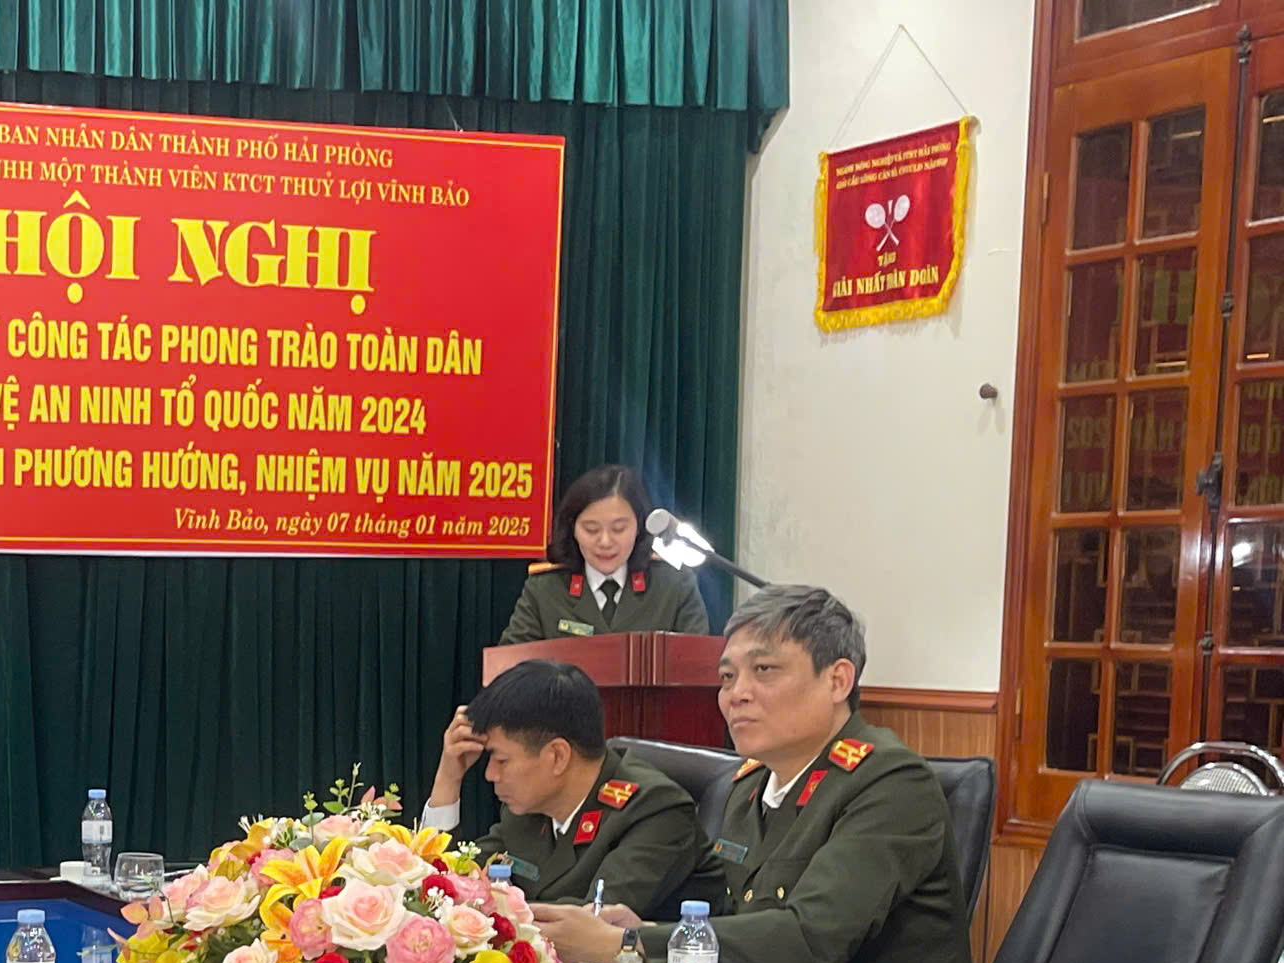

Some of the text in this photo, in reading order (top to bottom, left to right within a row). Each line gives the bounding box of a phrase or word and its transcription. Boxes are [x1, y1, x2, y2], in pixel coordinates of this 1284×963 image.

[39, 156, 86, 188] MỘT
[90, 159, 163, 187] THÀNH
[167, 164, 217, 190] VIÊN
[223, 171, 276, 194] KTCT
[45, 123, 105, 149] NHÂN
[110, 126, 154, 152] DÂN
[158, 129, 230, 157] THÀNH
[236, 133, 279, 160] PHỐ
[283, 135, 318, 163] HẢI
[324, 143, 393, 168] PHÒNG
[167, 217, 377, 315] NGHỊ
[7, 311, 88, 360] CÔNG
[96, 314, 152, 362] TÁC
[160, 324, 258, 366] PHONG
[266, 322, 338, 369] TRÀO
[346, 327, 418, 373] TOÀN
[426, 330, 482, 375] DÂN
[28, 384, 71, 423] AN
[79, 385, 152, 425] NINH
[160, 375, 197, 427] TỔ
[203, 380, 279, 432] QUỐC
[287, 386, 353, 432] NĂM
[360, 396, 427, 435] 2024
[14, 445, 133, 488] PHƯƠNG
[142, 441, 247, 496] HƯỚNG,
[256, 448, 347, 501] NHIỆM
[355, 457, 390, 502] VỤ
[398, 452, 461, 496] NĂM
[468, 461, 533, 498] 2025
[175, 508, 530, 537] Vĩnh Bảo, ngày 07 tháng 01 năm 2025
